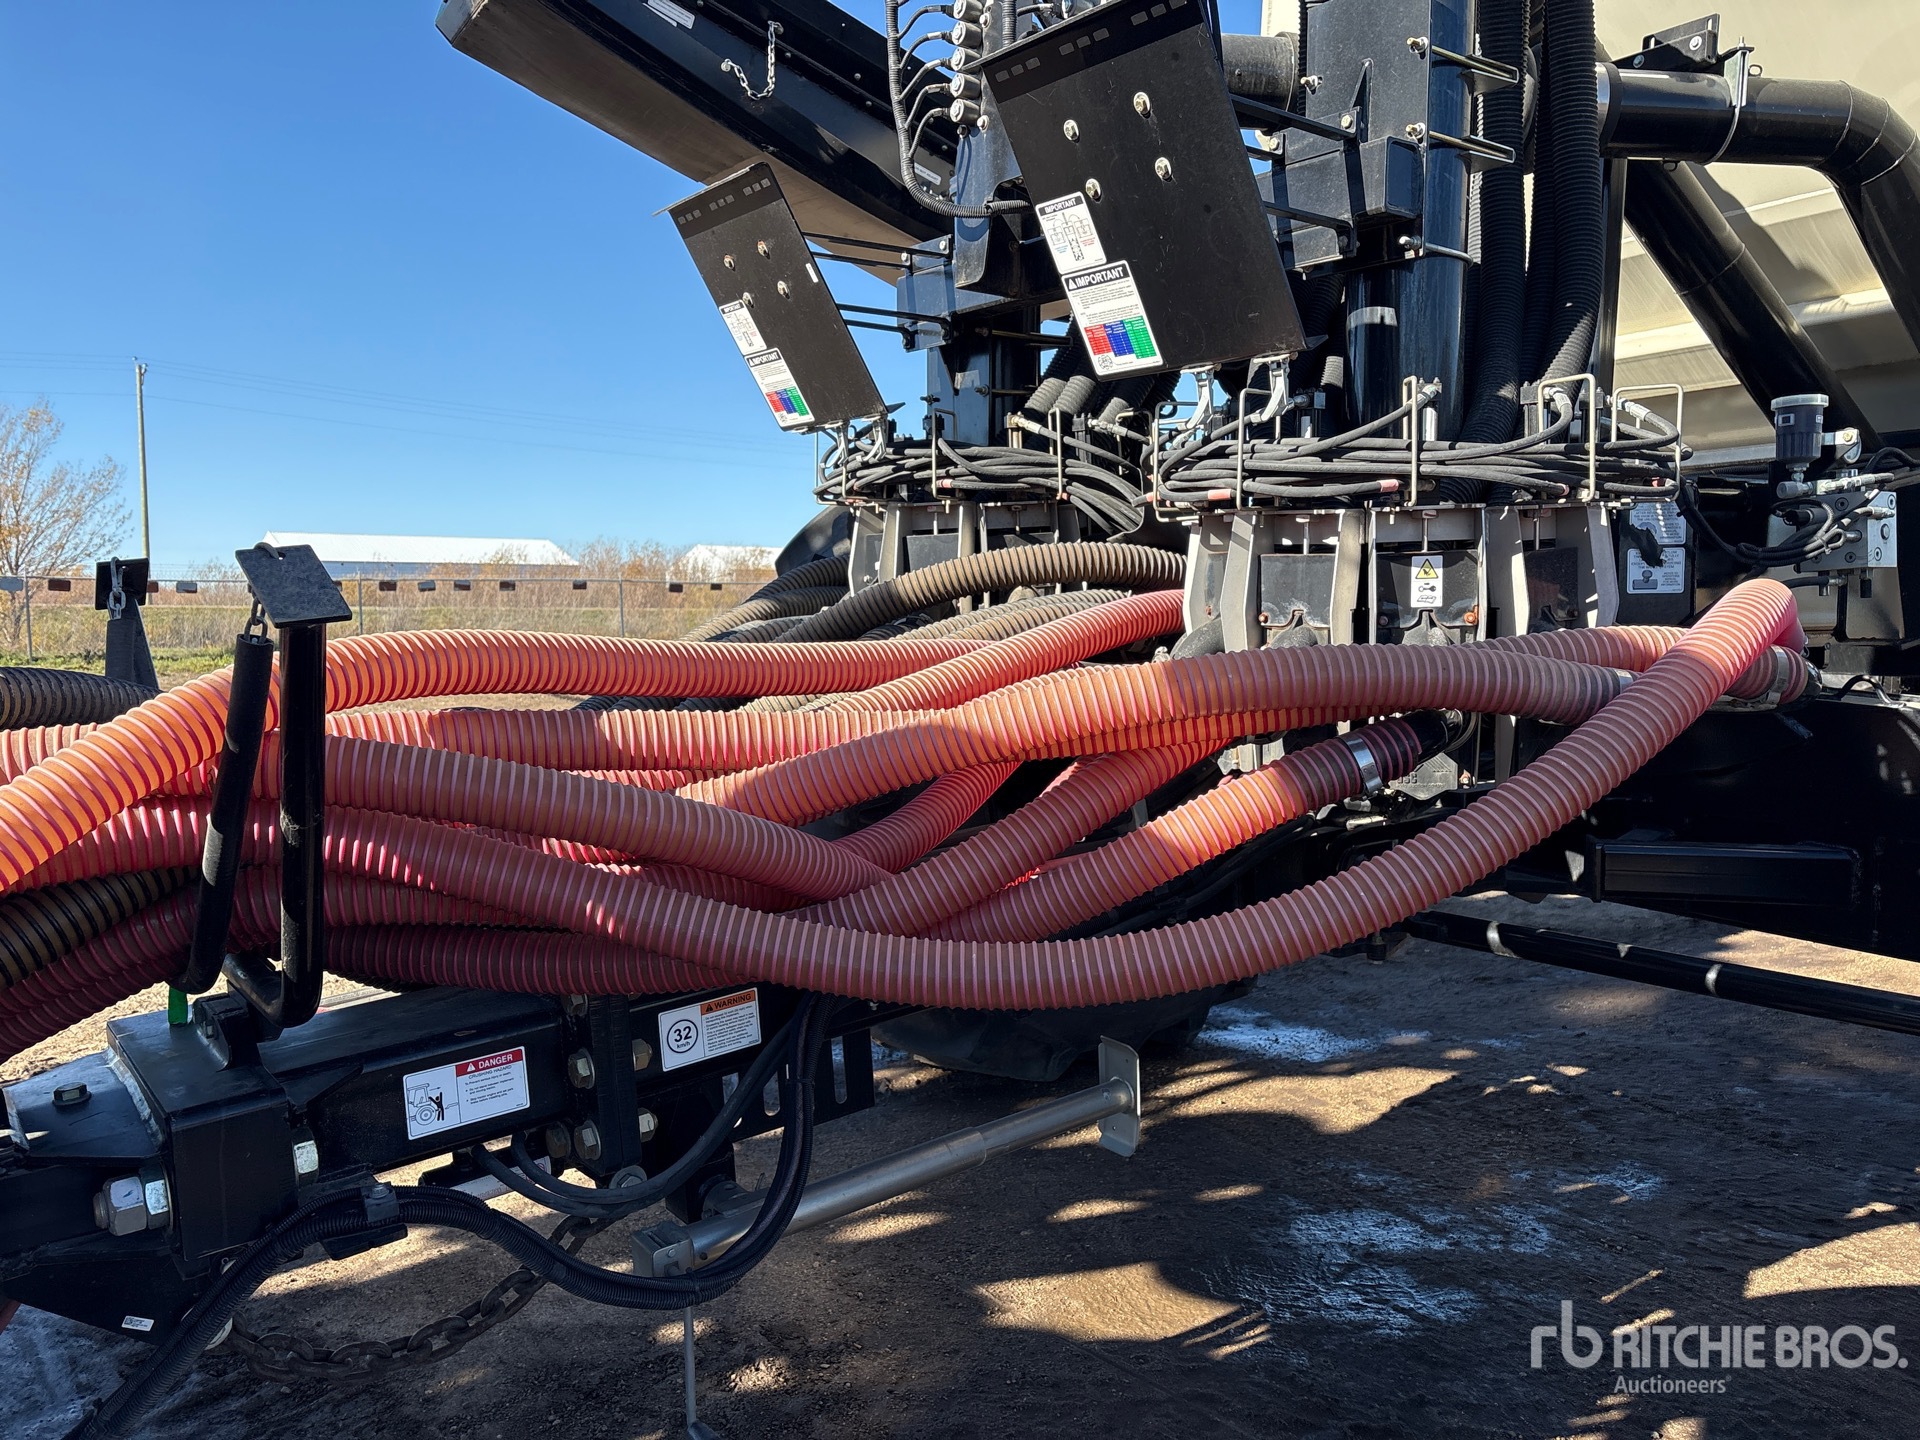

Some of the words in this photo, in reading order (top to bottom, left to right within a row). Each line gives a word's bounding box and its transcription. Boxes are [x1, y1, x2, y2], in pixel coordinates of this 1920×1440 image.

[1044, 198, 1077, 213] IMPORTANT
[1075, 267, 1124, 287] IMPORTANT
[714, 994, 752, 1009] WARNING
[674, 1026, 692, 1042] 32
[676, 1041, 691, 1049] km/h
[478, 1054, 513, 1069] DANGER
[468, 1070, 493, 1080] CRUSHING
[493, 1065, 512, 1073] HAZARD
